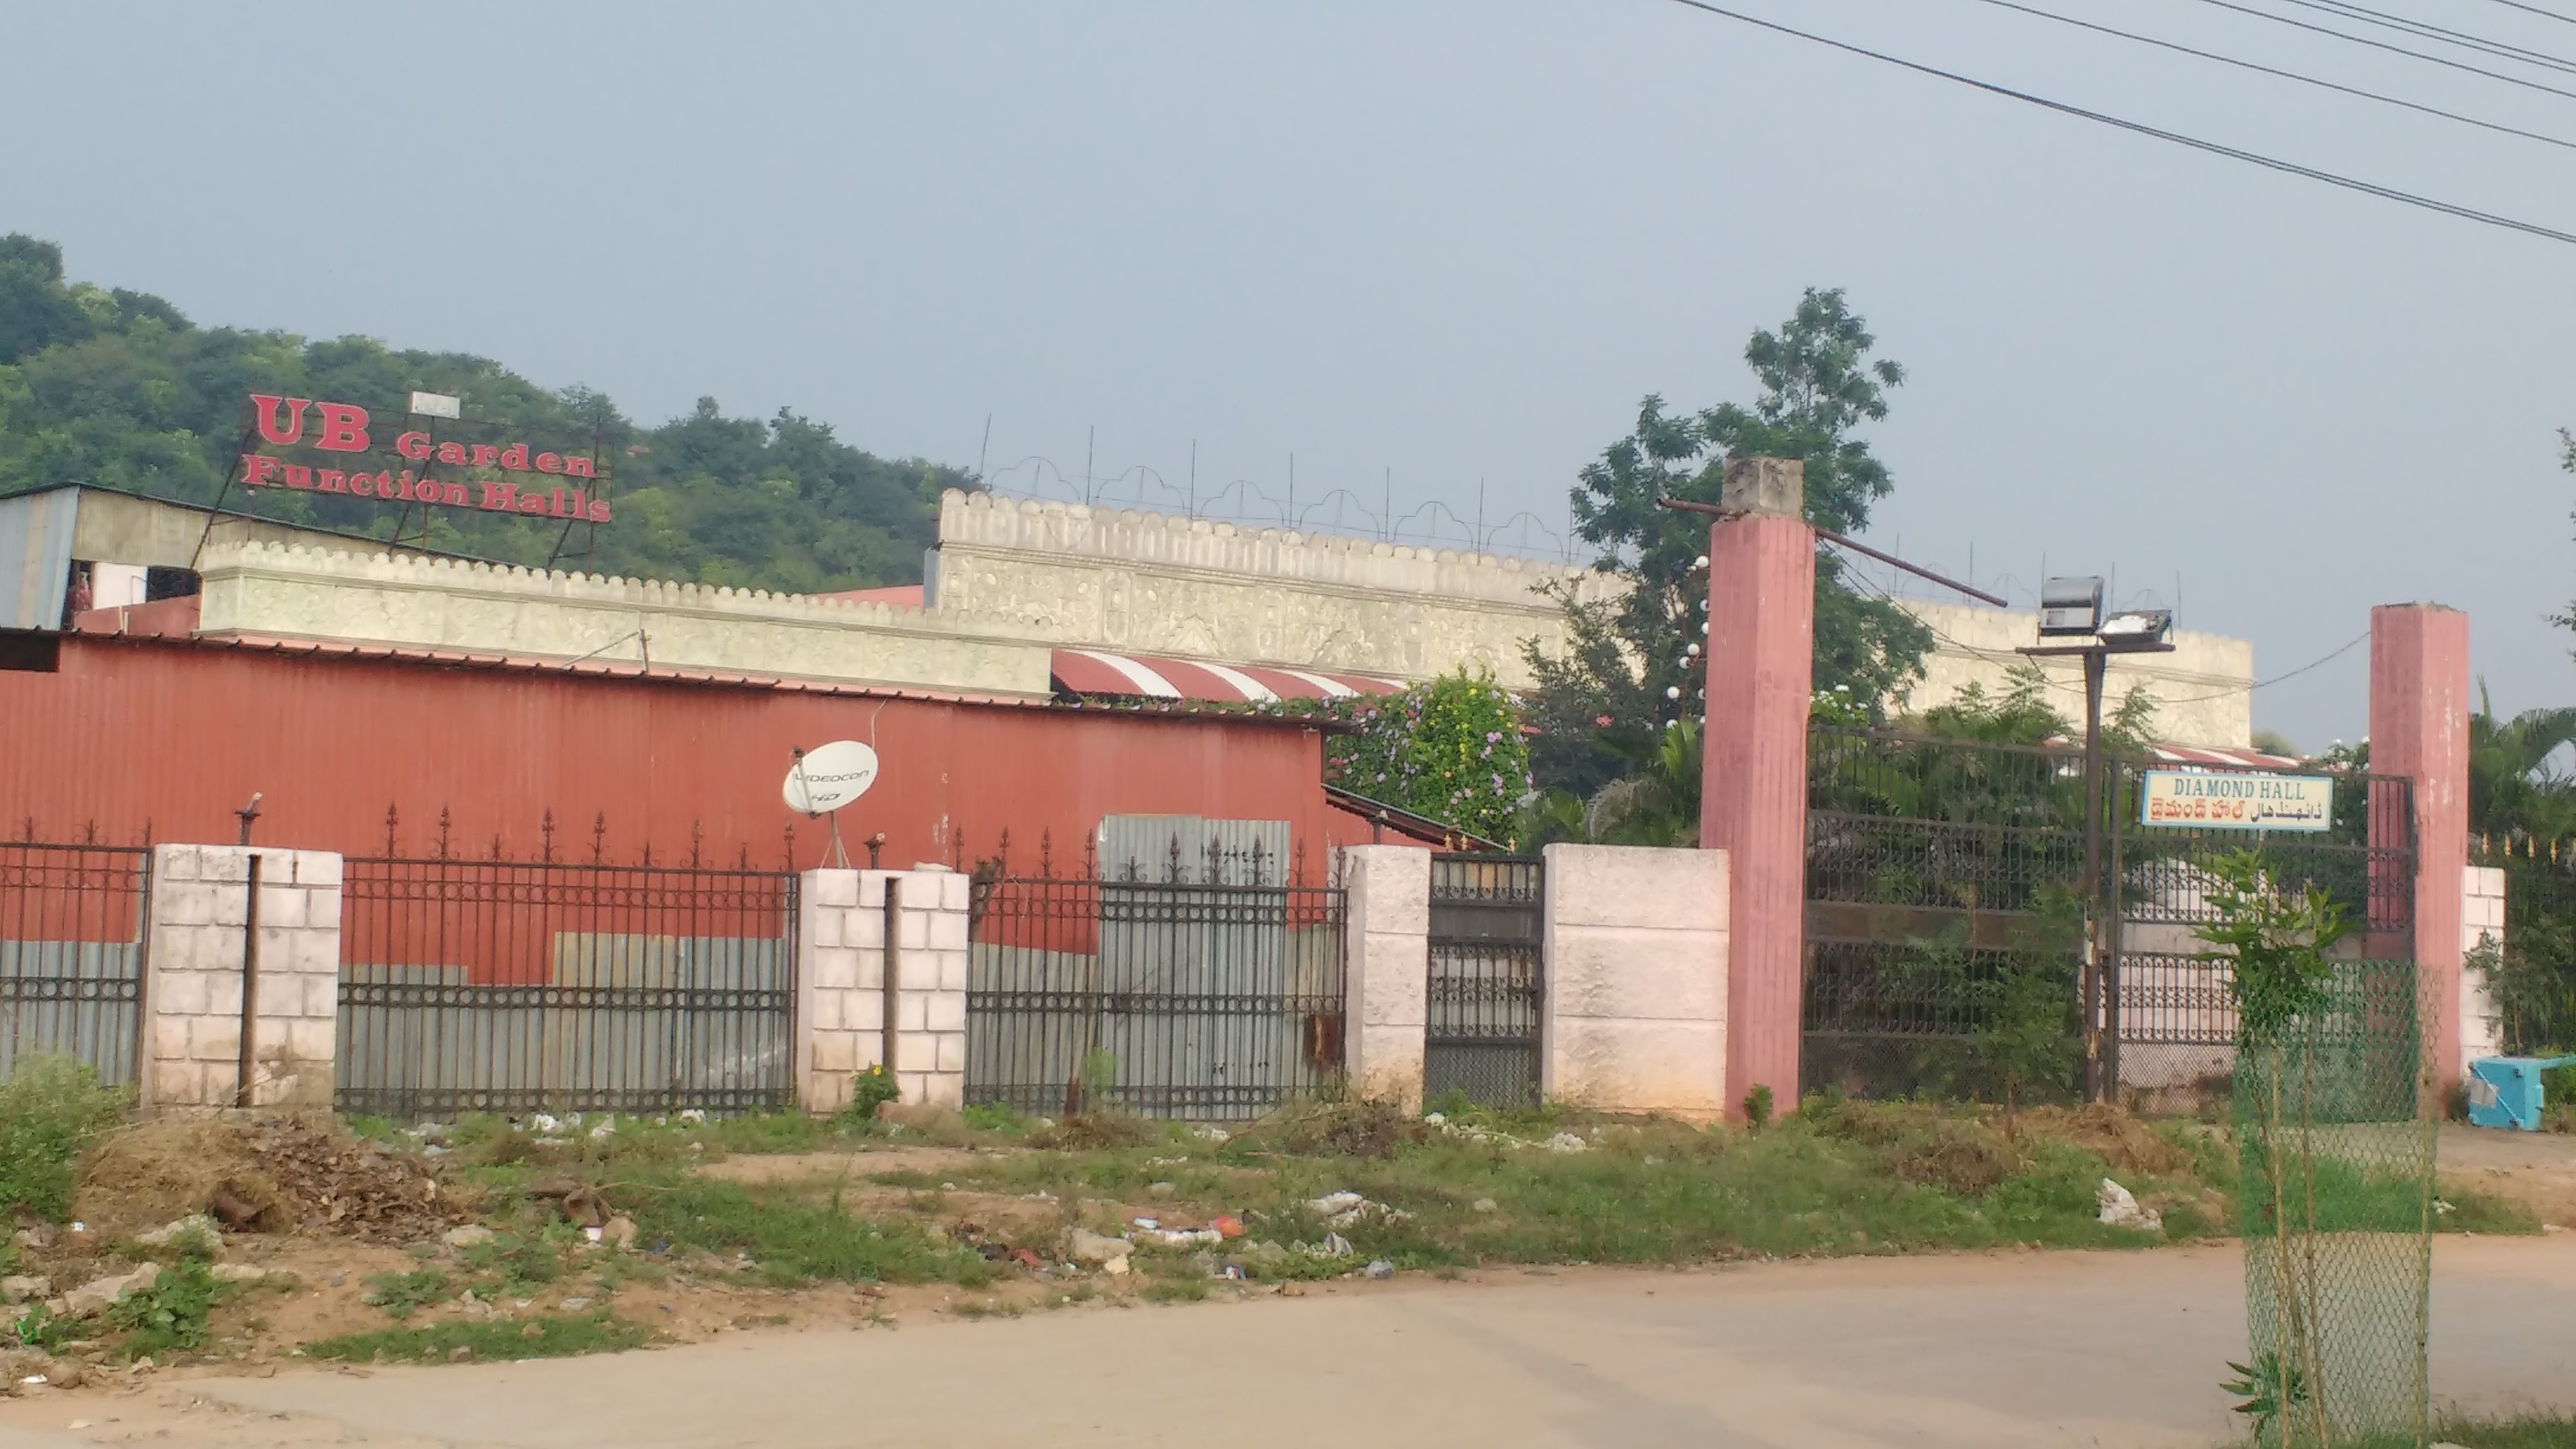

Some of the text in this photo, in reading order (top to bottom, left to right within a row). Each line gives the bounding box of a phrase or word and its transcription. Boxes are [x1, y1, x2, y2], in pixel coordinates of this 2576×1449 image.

[250, 394, 597, 478] UB Garden
[241, 453, 611, 523] Function Halls
[2174, 779, 2305, 800] DIAMOND HALL
